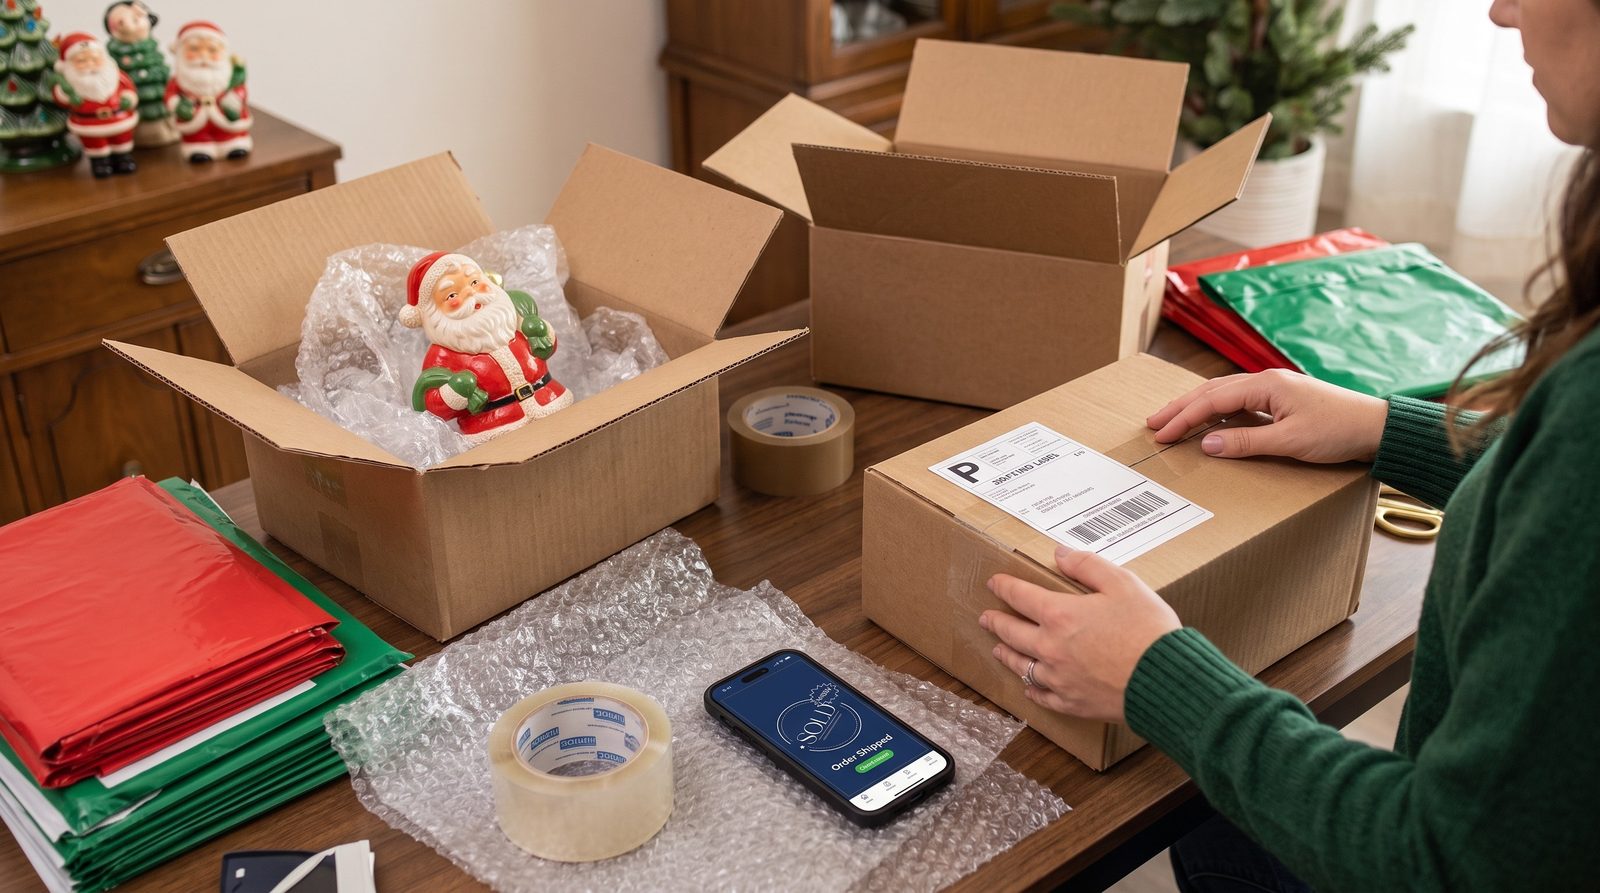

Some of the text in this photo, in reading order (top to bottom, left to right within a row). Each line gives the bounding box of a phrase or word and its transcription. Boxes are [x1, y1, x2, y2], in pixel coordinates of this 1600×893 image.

[947, 462, 979, 484] P
[796, 703, 836, 745] SOLD
[831, 754, 857, 771] Order
[856, 733, 893, 757] Shipped
